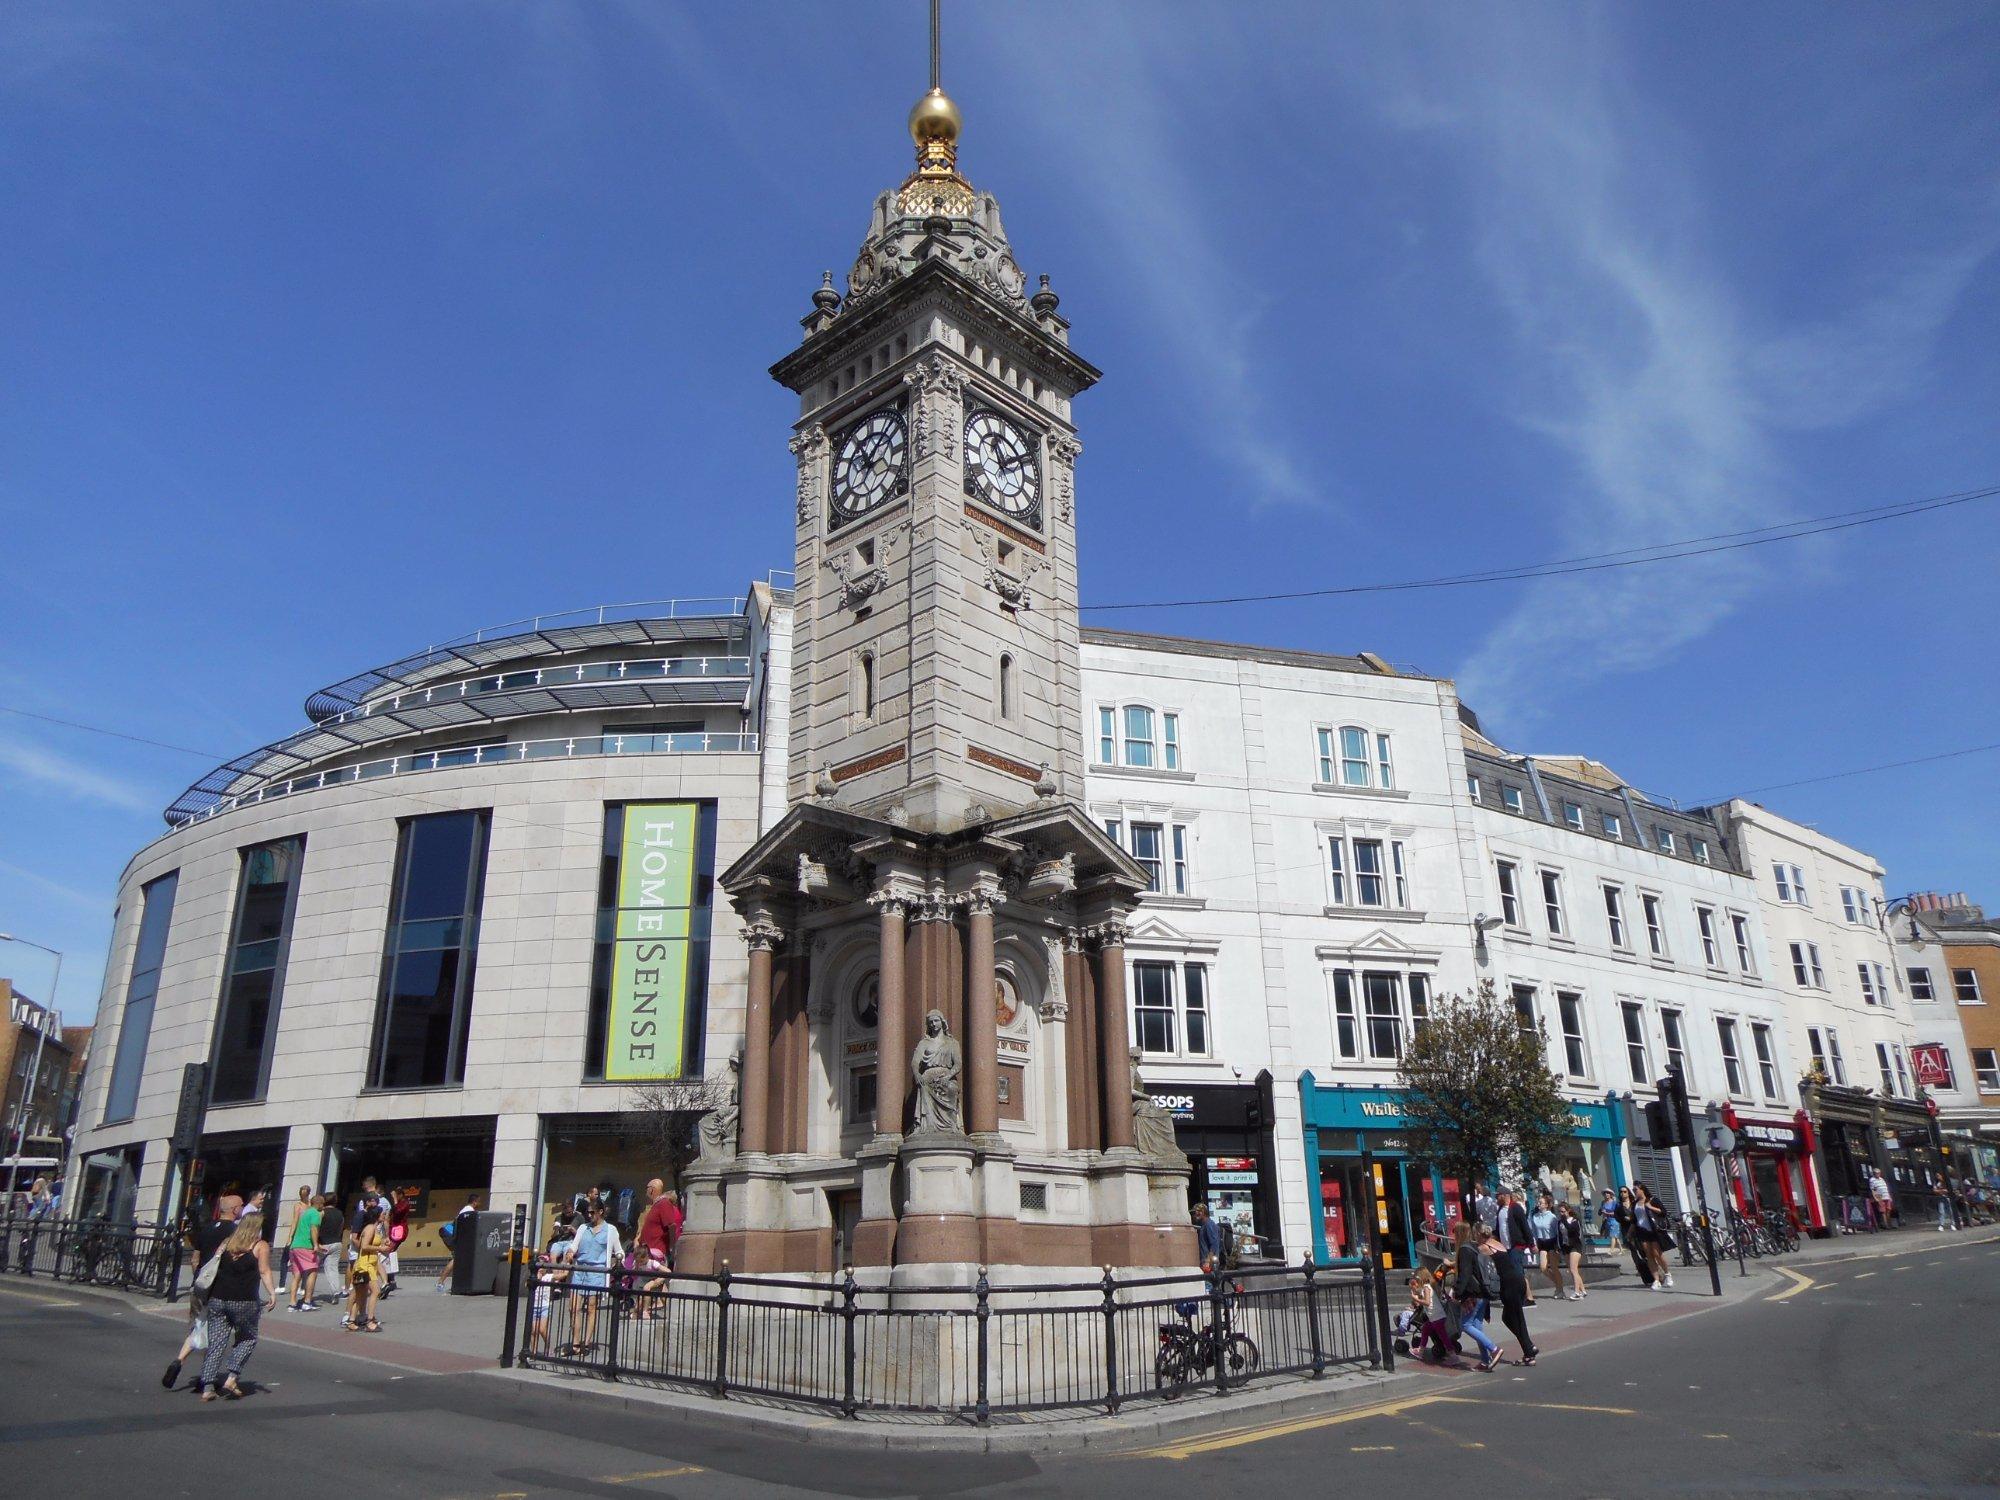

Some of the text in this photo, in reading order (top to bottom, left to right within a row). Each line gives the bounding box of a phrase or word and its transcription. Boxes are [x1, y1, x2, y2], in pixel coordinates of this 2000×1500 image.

[1745, 1126, 1794, 1142] THE QUAD
[1233, 1174, 1247, 1183] print
[1428, 1204, 1457, 1217] SLE
